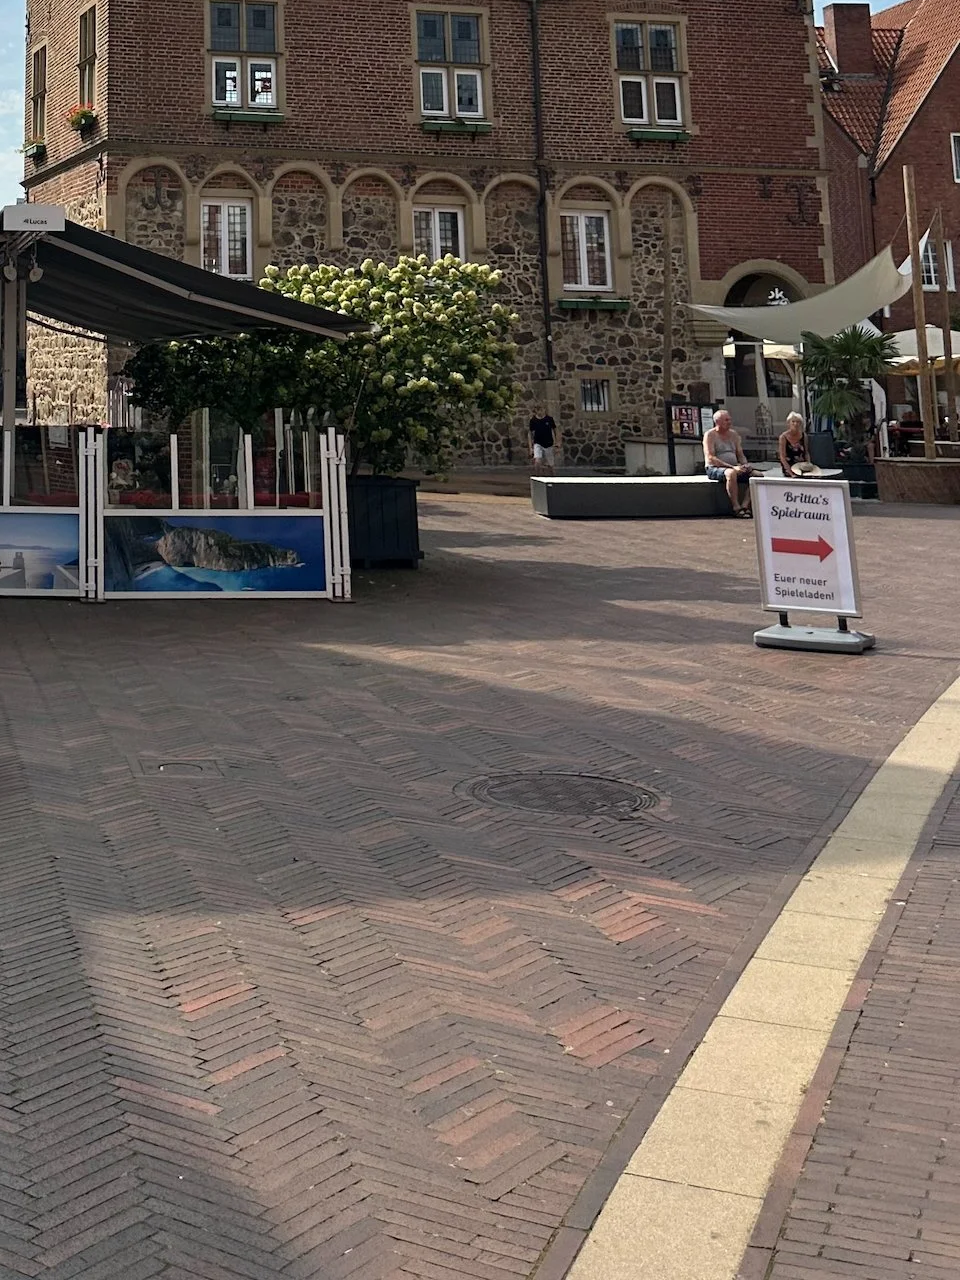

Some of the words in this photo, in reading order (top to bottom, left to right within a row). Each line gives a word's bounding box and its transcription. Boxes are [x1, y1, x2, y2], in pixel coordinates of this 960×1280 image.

[783, 492, 829, 505] Britta's
[770, 506, 831, 521] Spielraum
[774, 573, 796, 583] Euer
[799, 576, 827, 586] neuer
[775, 587, 835, 600] Spieleladen!
